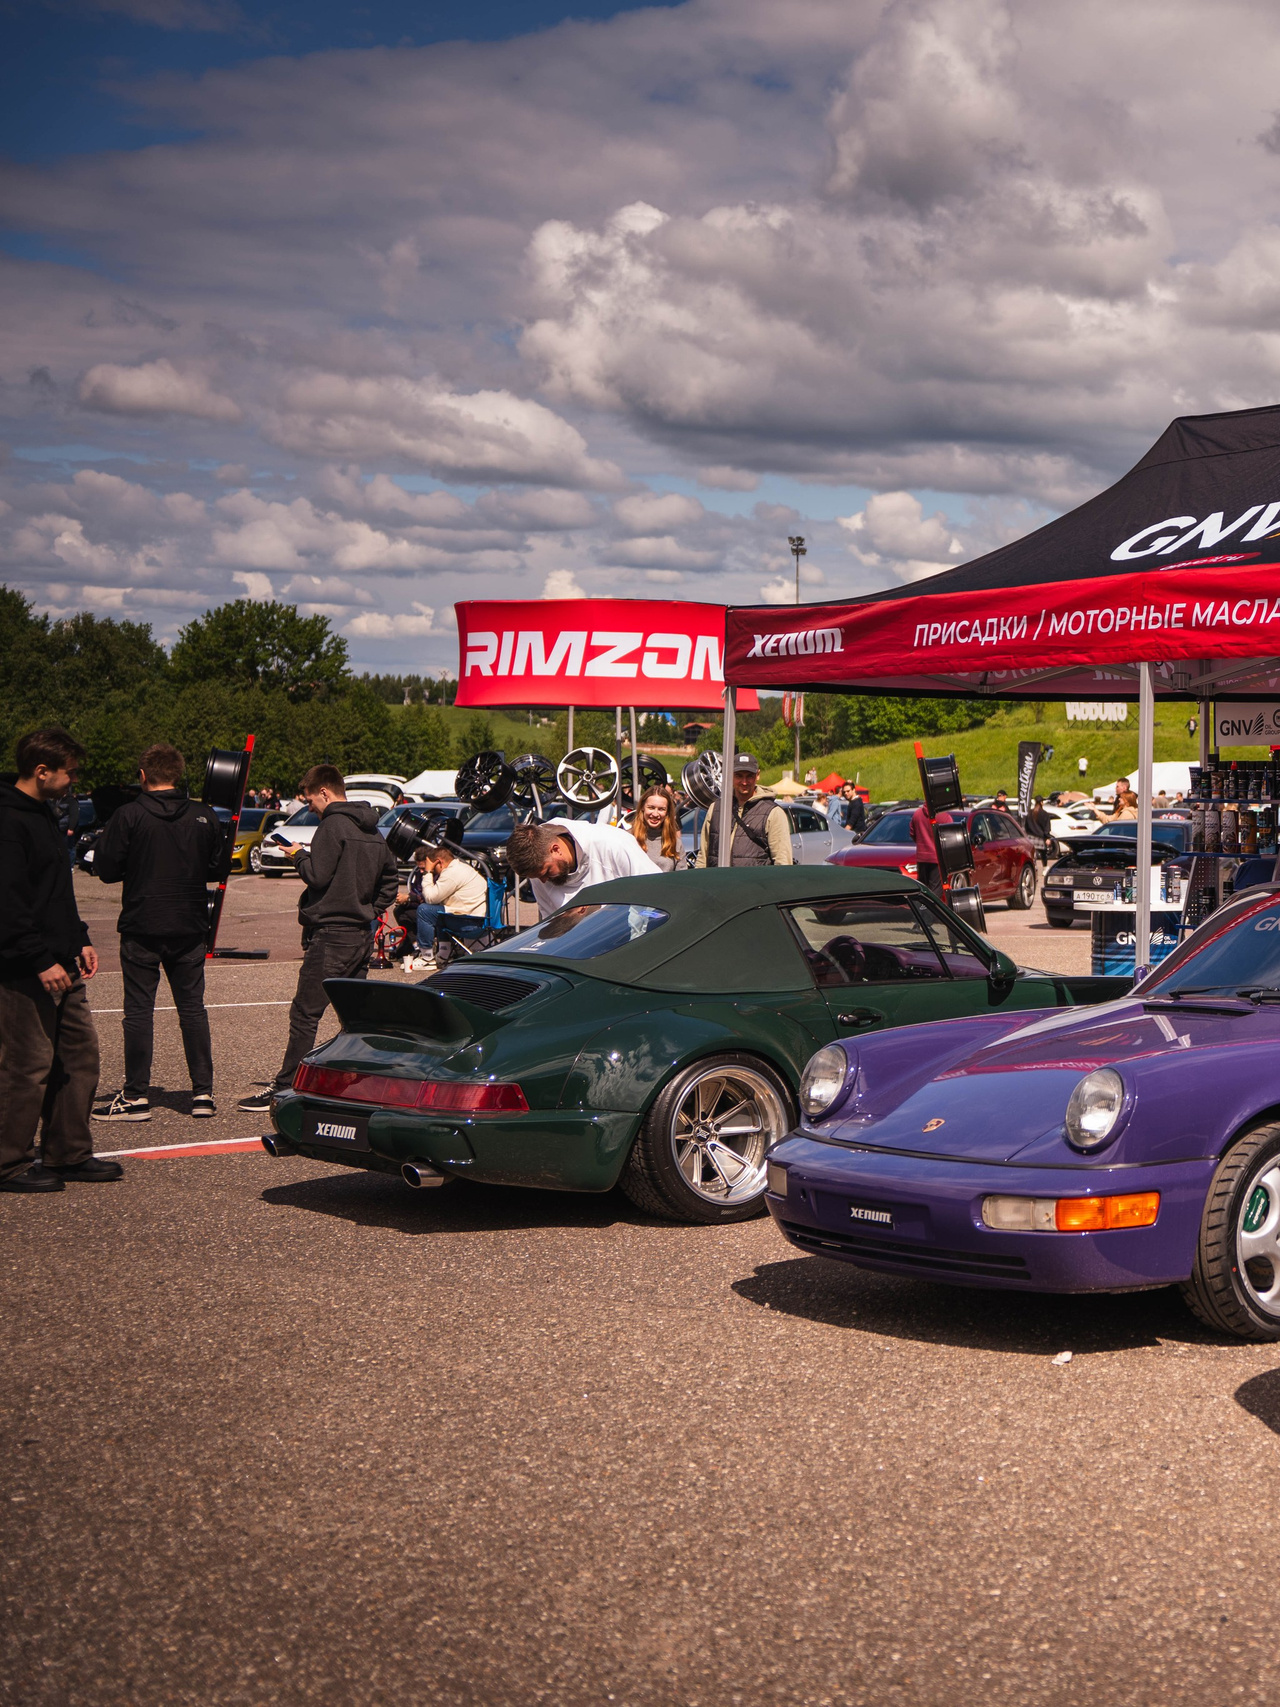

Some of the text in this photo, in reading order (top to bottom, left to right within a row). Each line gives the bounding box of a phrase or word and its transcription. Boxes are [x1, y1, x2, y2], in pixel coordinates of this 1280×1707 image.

[913, 615, 1028, 647] ПРИСАДКИ
[1048, 602, 1187, 637] МОТОРНЫЕ
[746, 627, 845, 658] XENUM
[1219, 719, 1254, 737] GNV
[315, 1122, 357, 1140] XENUM
[850, 1207, 892, 1224] XENUM
